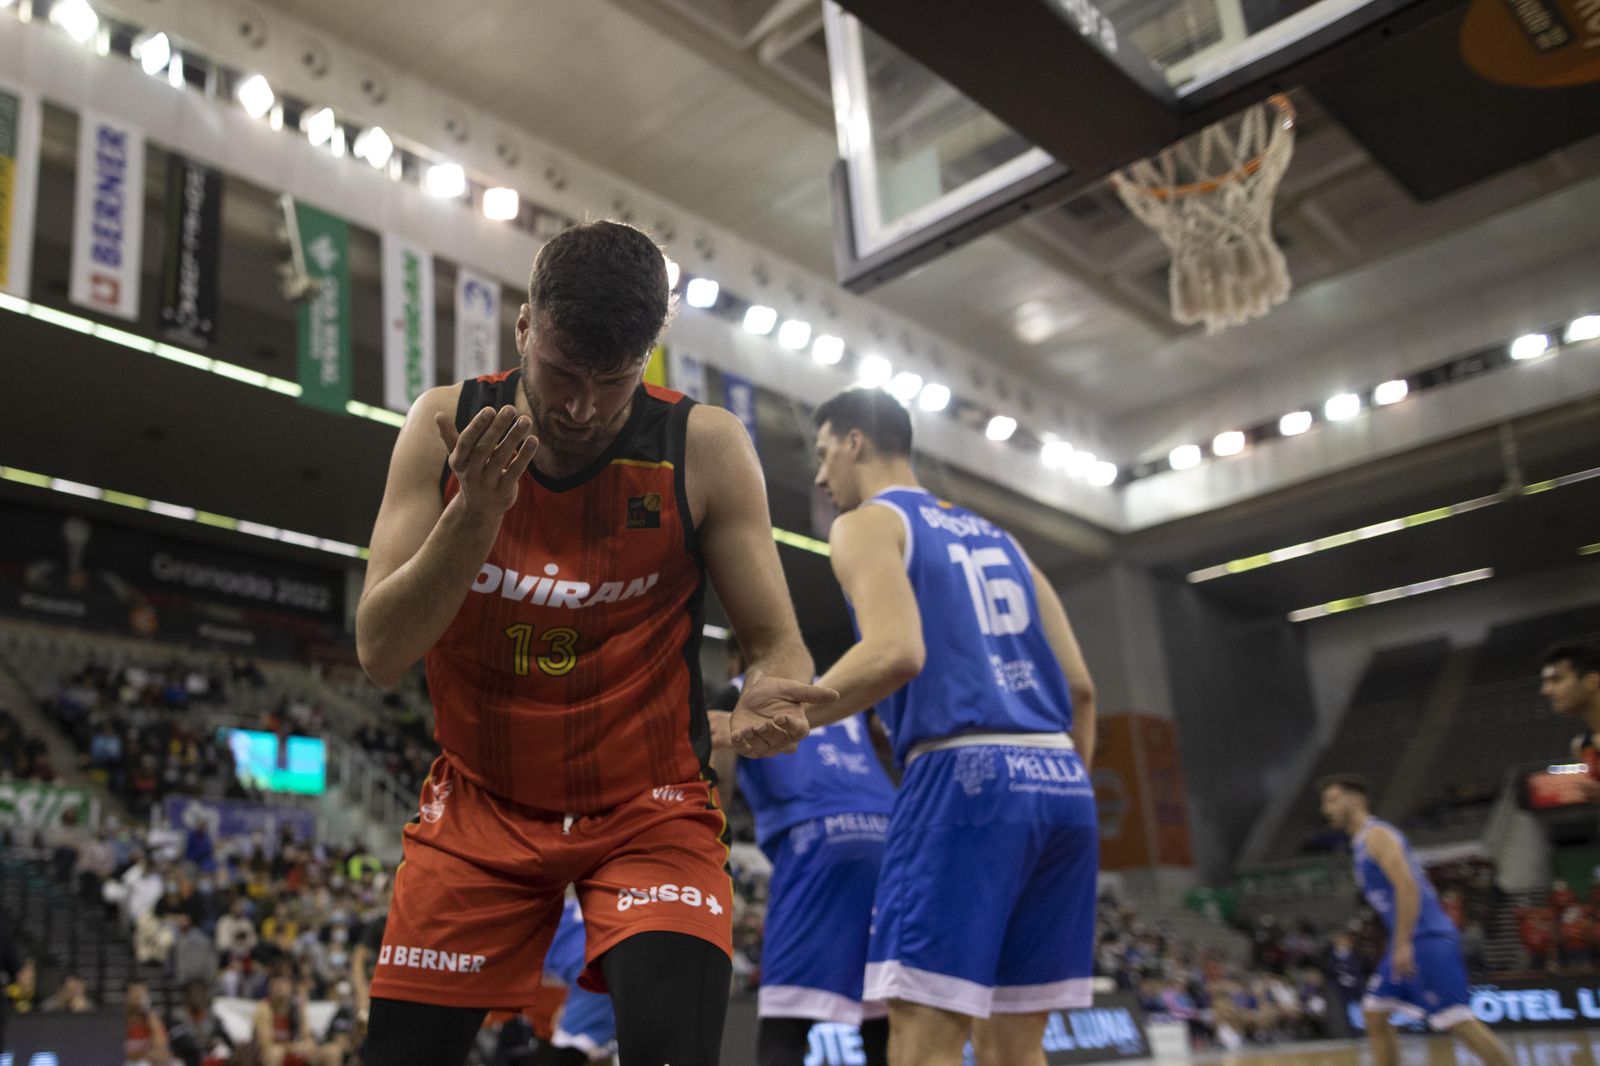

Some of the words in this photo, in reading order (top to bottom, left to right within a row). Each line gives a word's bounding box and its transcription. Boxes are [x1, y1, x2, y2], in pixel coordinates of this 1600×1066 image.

[92, 125, 126, 268] BERNER
[947, 543, 1031, 636] 16
[504, 624, 579, 676] 13
[393, 946, 486, 972] BERNER
